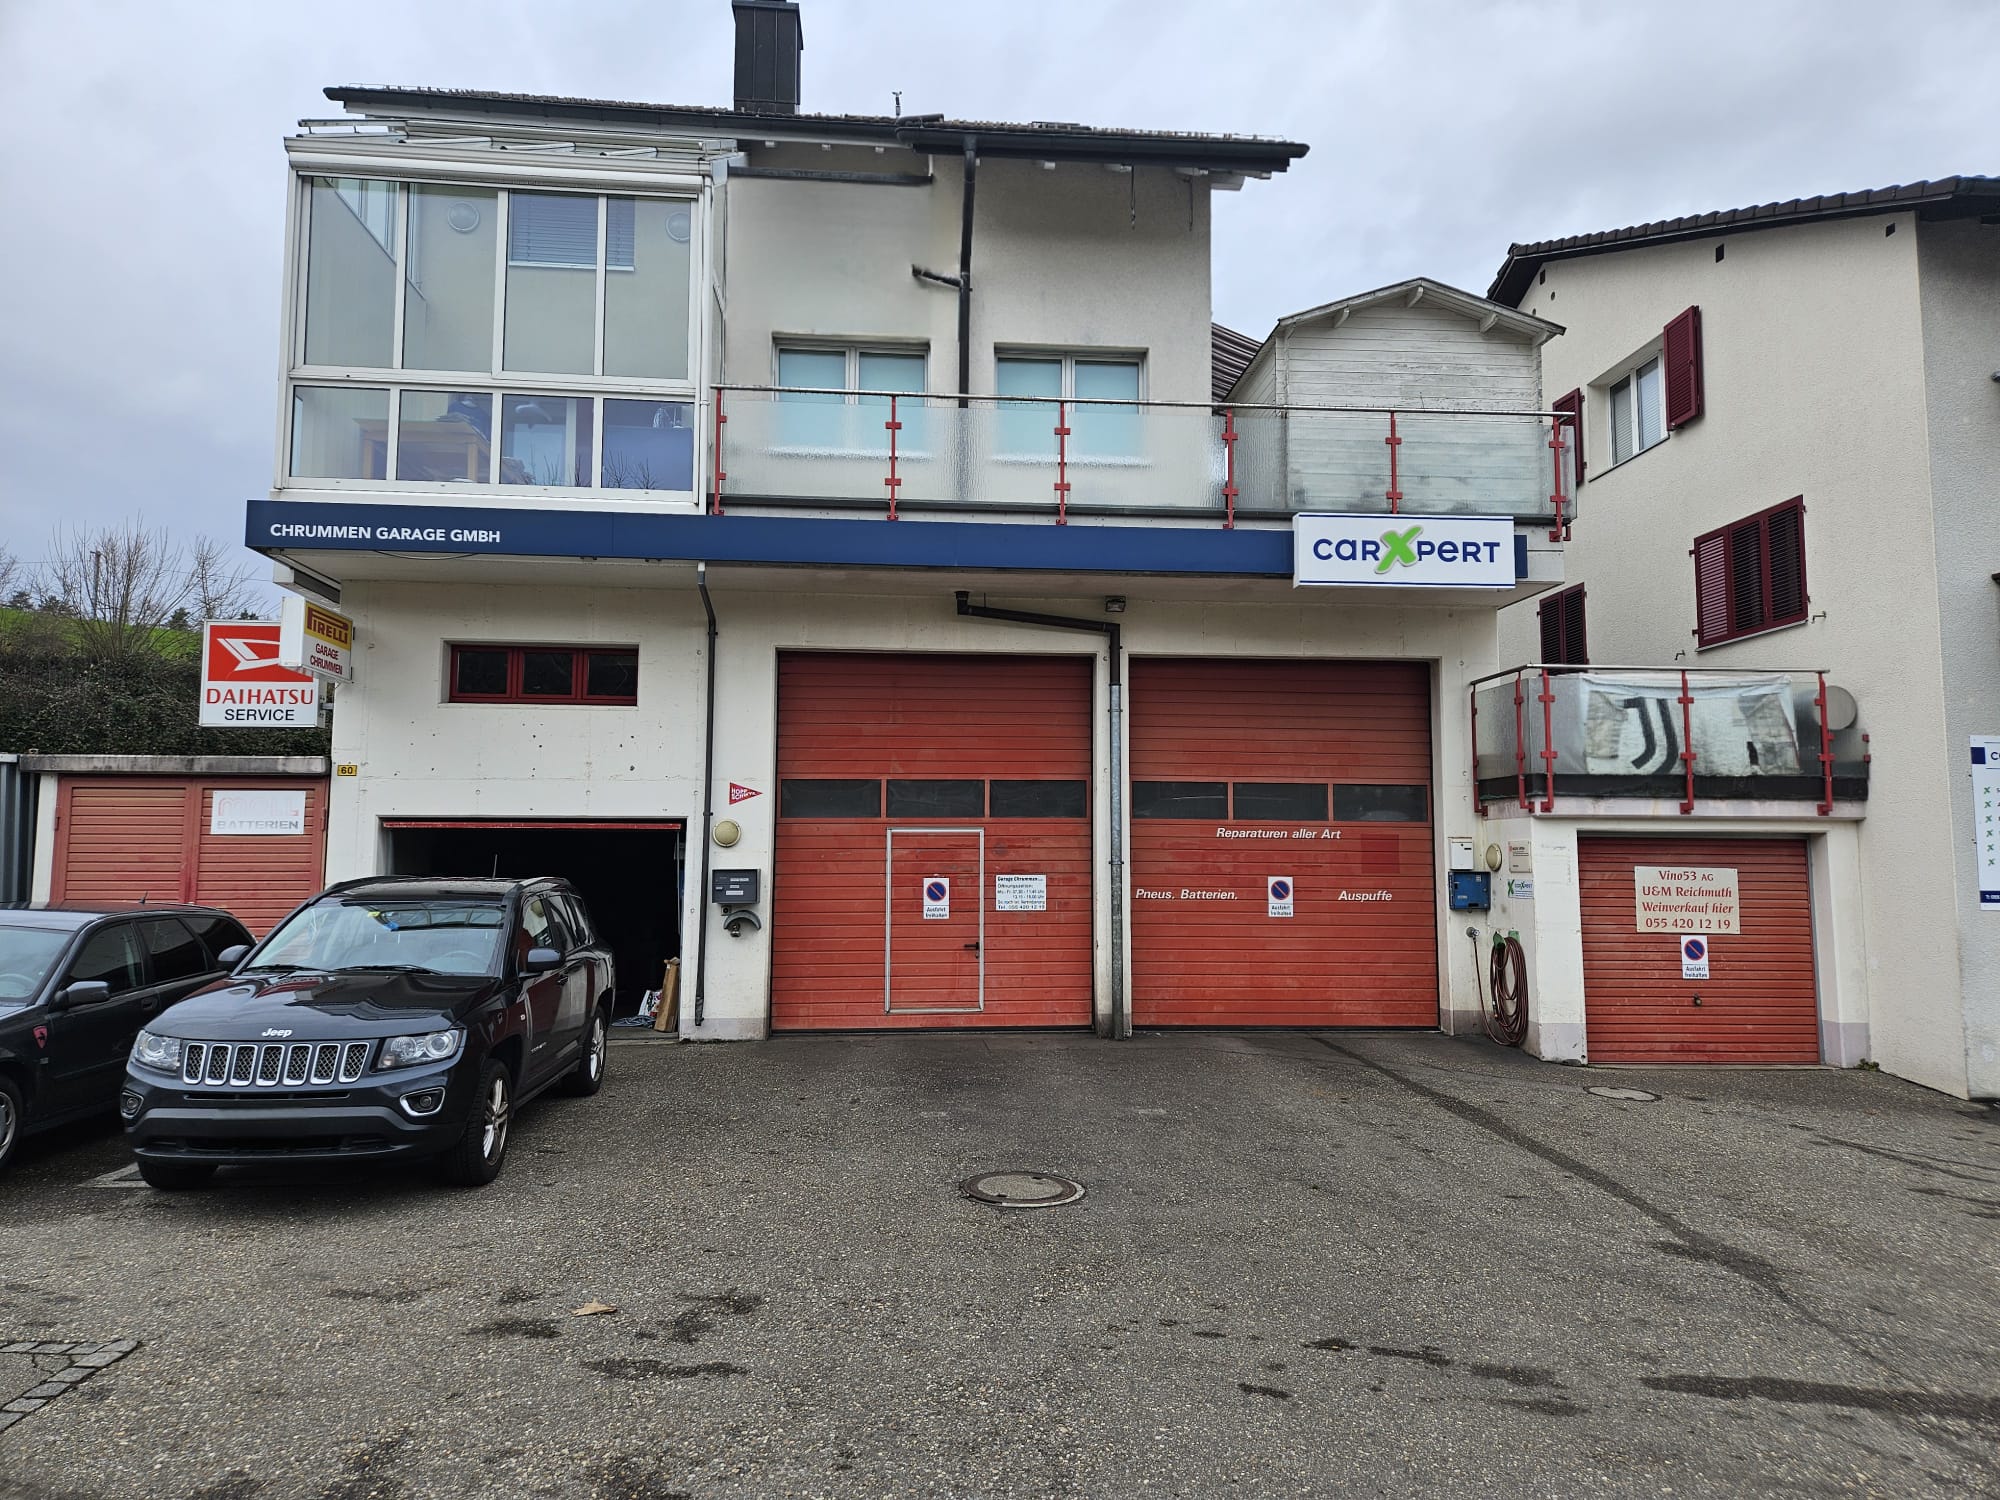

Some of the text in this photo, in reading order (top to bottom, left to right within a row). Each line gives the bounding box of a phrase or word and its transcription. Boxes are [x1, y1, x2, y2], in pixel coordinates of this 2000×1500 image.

[270, 523, 501, 543] CHRUMMEN GARAGE GMBH
[307, 606, 349, 645] PIRELLI
[315, 643, 339, 661] GARAGE
[310, 656, 343, 675] CHRUMMEN
[206, 688, 314, 705] DAIHATSU
[224, 709, 295, 721] SERVICE
[340, 766, 353, 775] 60
[217, 820, 299, 830] BATTERIEN
[1216, 827, 1342, 840] Reparaturen aller Art
[1658, 870, 1714, 882] Vino53 AG
[1338, 890, 1393, 902] Auspuffe
[1642, 885, 1732, 898] U&M Reichmuth
[1642, 902, 1734, 915] Weinverkauf hier
[1645, 918, 1731, 929] 055 420 12 19
[261, 1028, 293, 1038] Jeep
